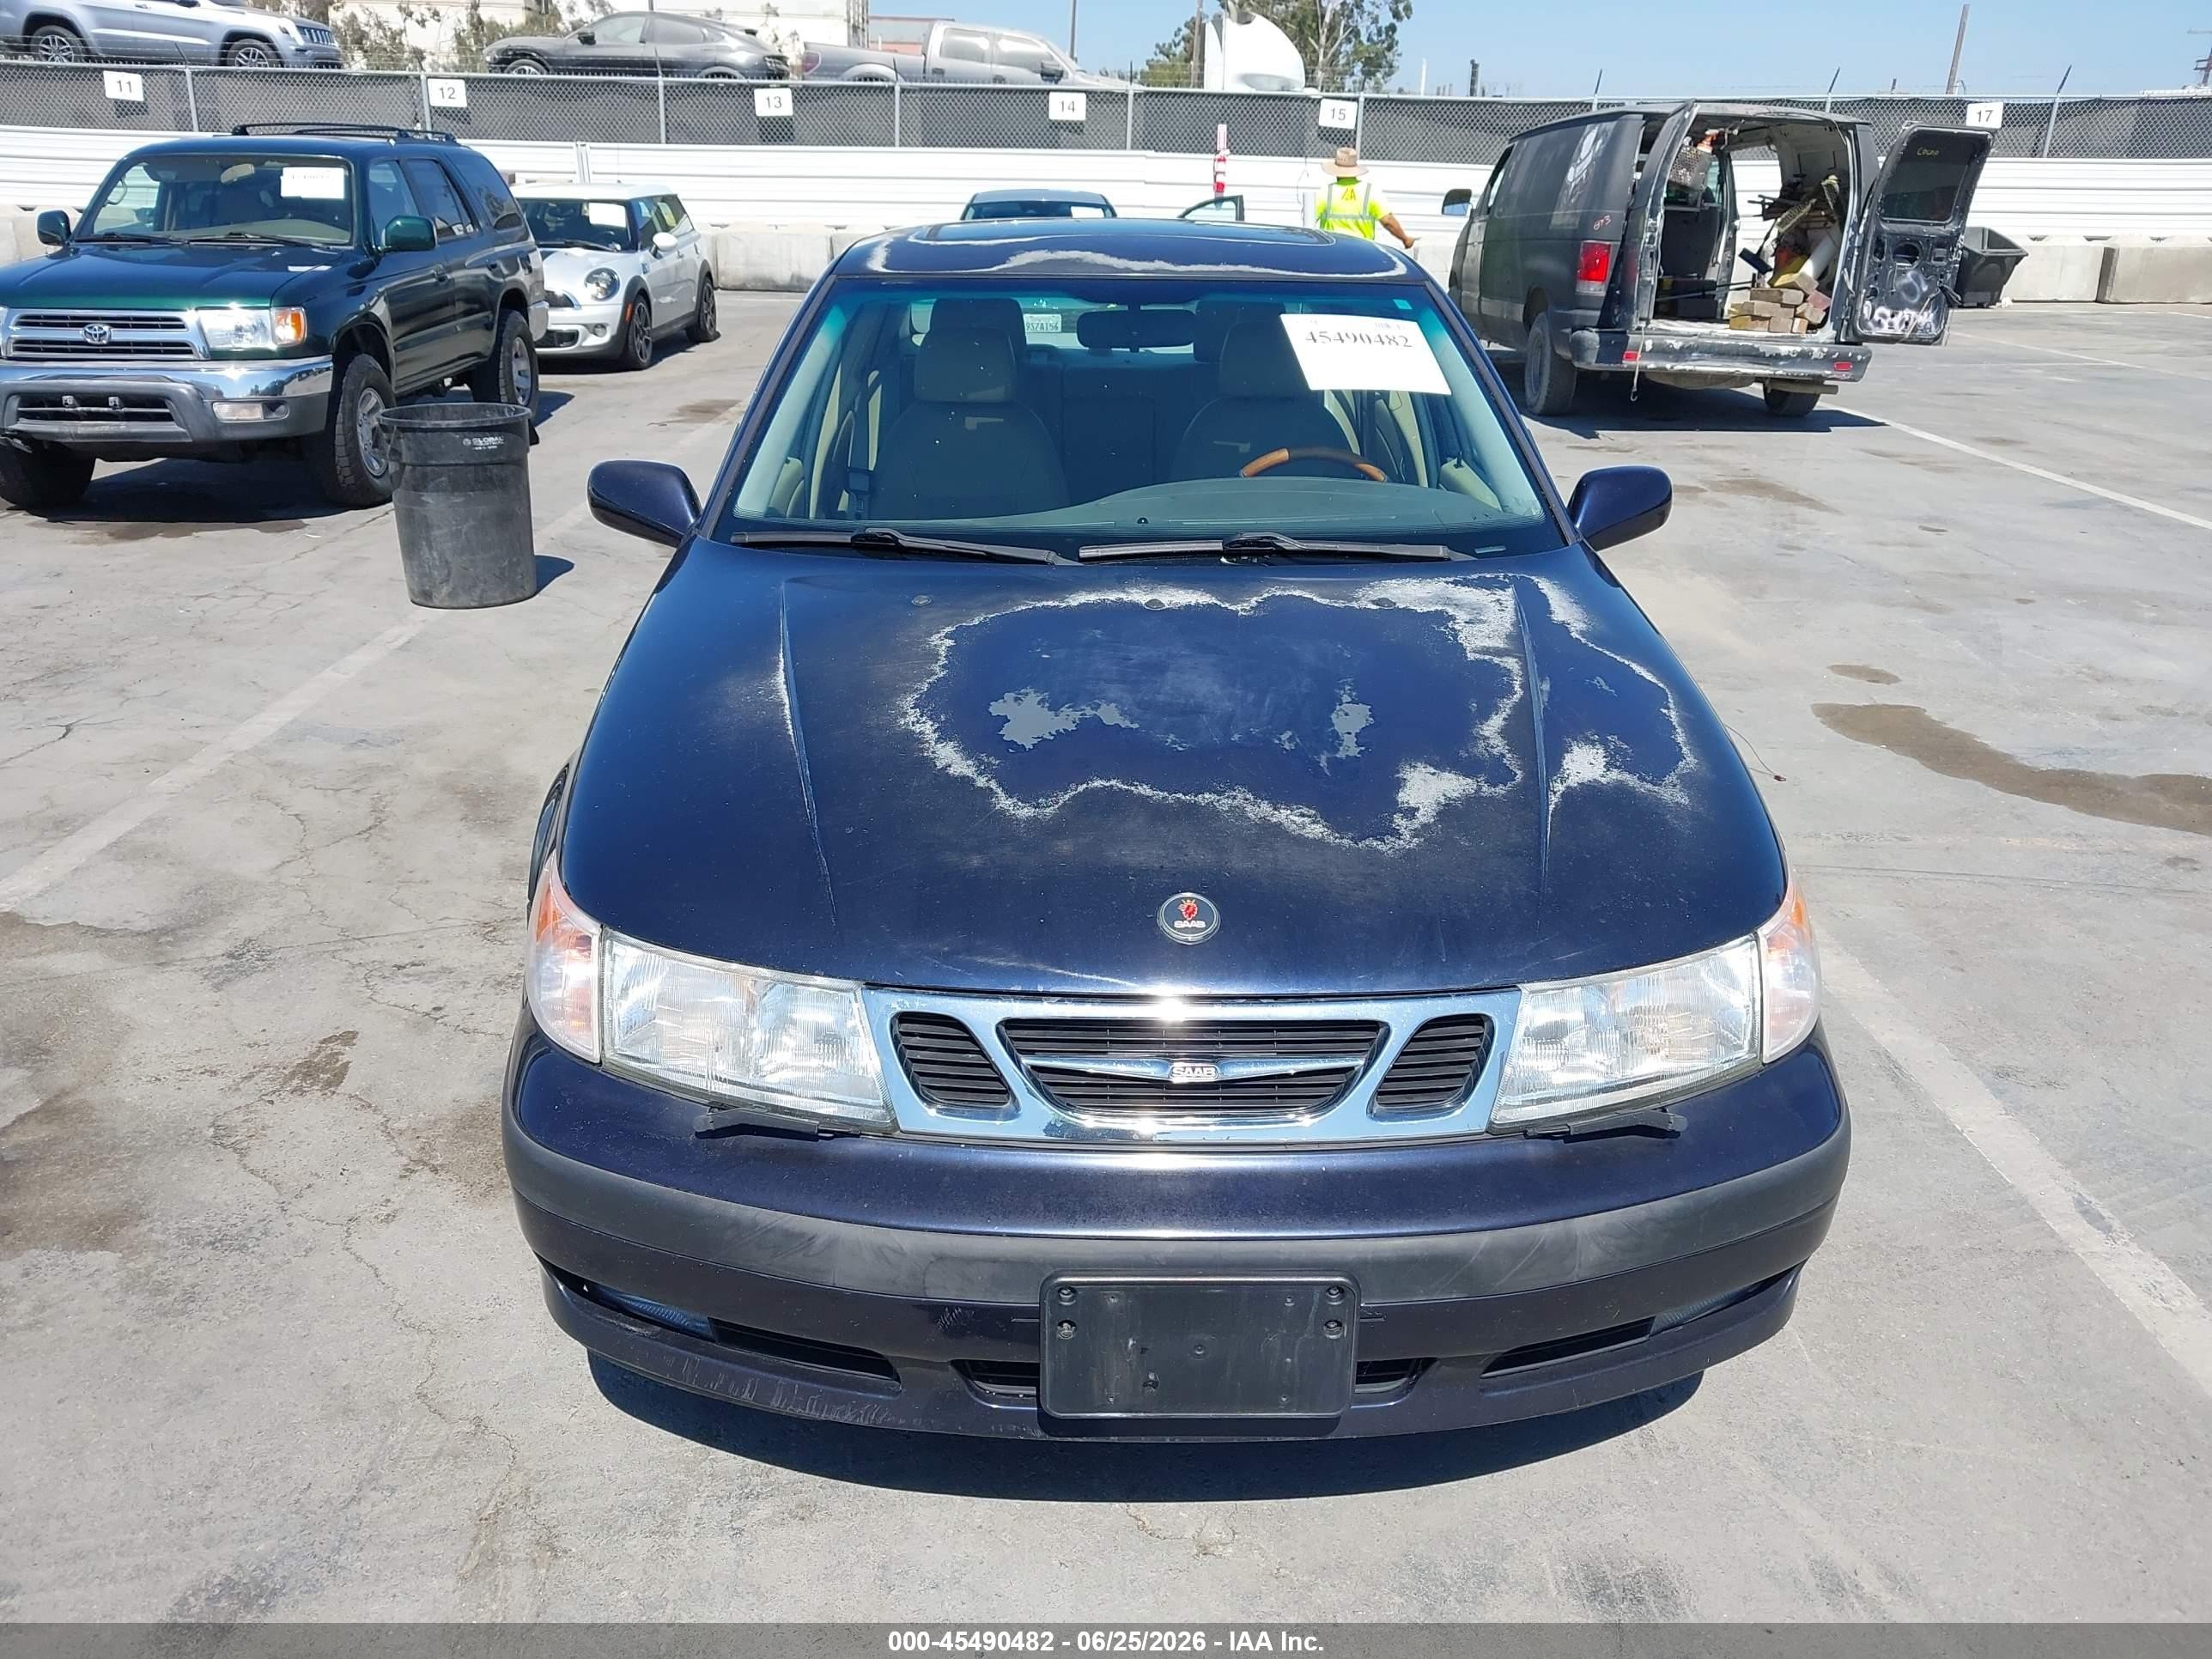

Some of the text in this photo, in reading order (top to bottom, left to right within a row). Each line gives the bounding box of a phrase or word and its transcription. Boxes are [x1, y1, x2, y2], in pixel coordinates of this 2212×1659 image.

[116, 80, 132, 93] 11
[439, 87, 456, 100] 12
[766, 95, 782, 108] 13
[1060, 100, 1075, 112] 14
[1331, 106, 1346, 121] 15
[1977, 109, 1994, 123] 17
[1304, 330, 1413, 348] 45490482
[1174, 920, 1206, 928] SAAB
[1172, 1066, 1217, 1078] SAAB
